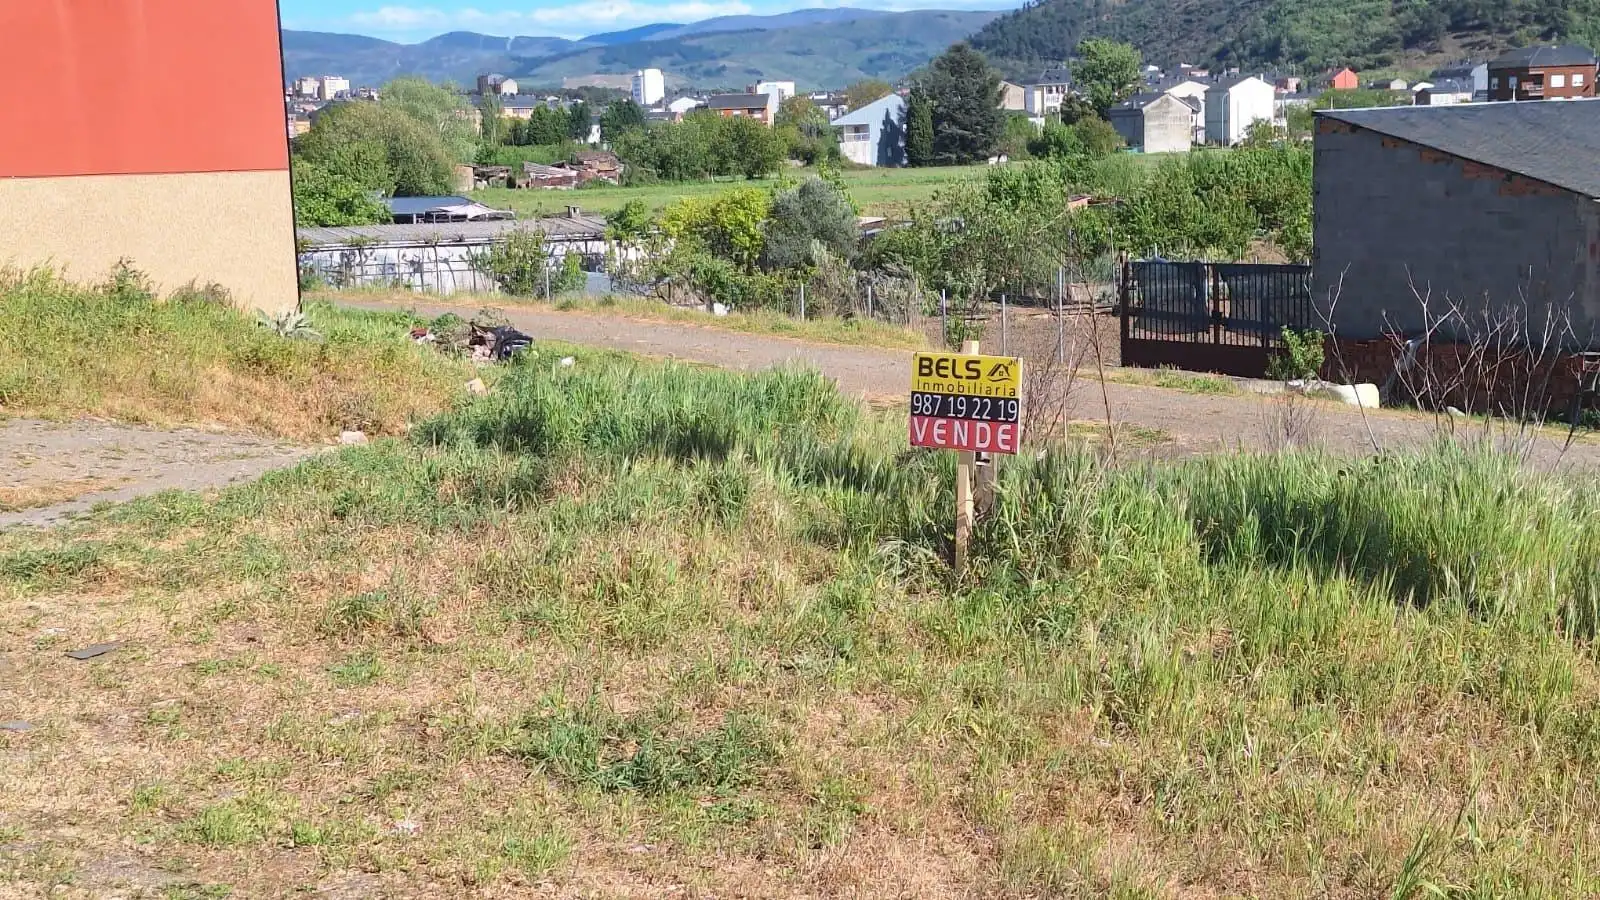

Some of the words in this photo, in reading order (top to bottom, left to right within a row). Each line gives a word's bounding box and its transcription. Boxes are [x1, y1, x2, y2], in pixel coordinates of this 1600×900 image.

[919, 357, 981, 380] BELS
[917, 379, 1016, 397] Inmobiliaria
[913, 393, 942, 416] 987
[947, 396, 967, 418] 19
[971, 398, 991, 420] 22
[998, 400, 1018, 422] 19
[913, 417, 1012, 450] VENDE
